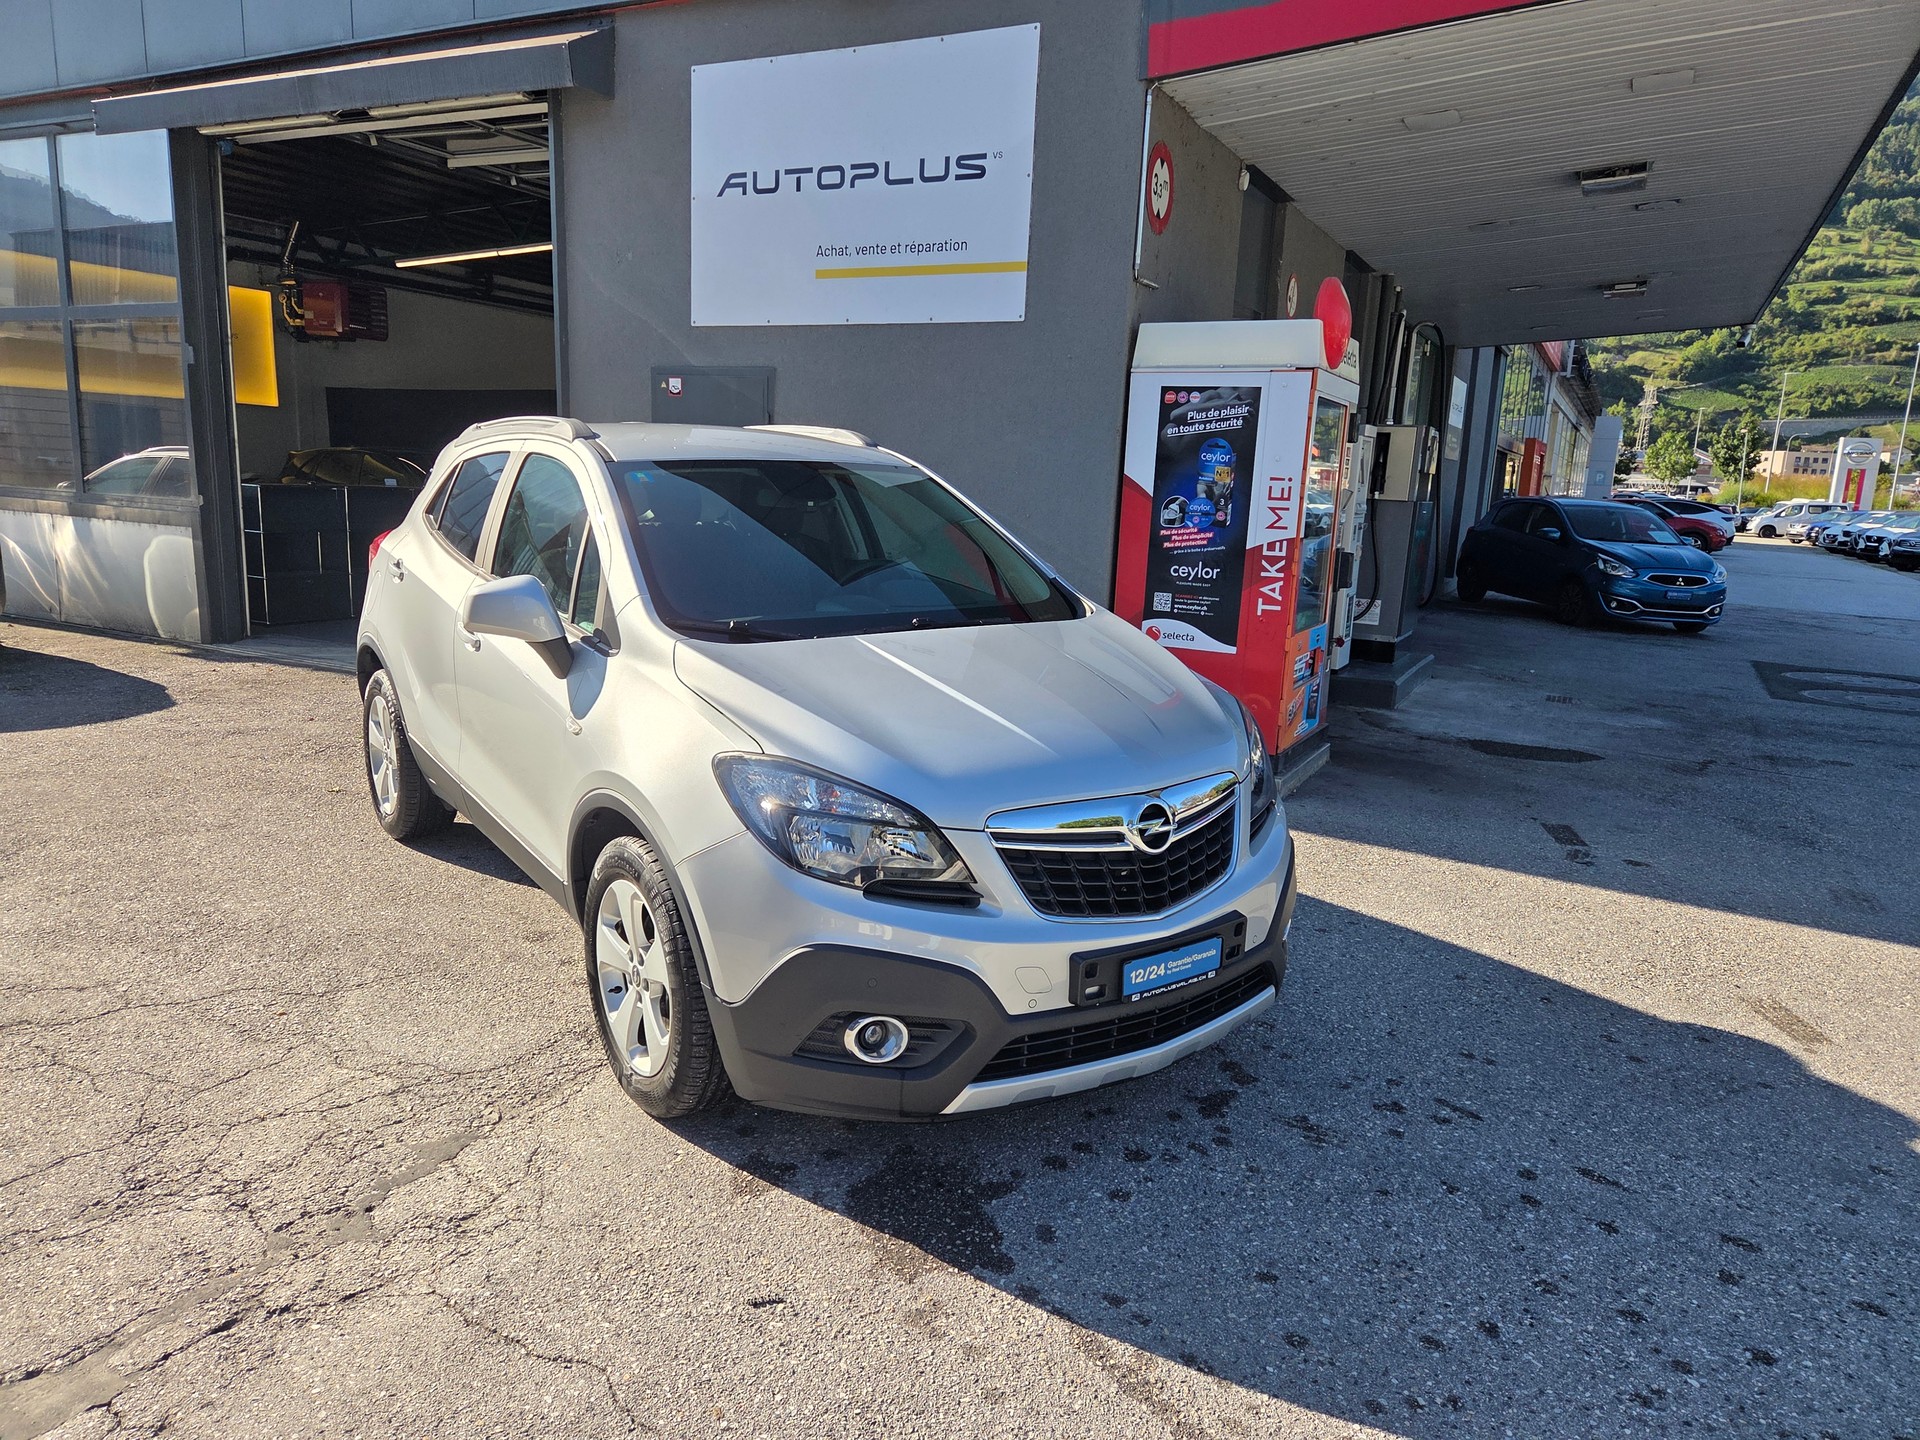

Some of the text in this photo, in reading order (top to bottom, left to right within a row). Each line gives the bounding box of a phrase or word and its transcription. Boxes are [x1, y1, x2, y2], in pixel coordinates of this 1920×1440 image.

[716, 151, 1004, 198] AUTOPLUS VS
[816, 239, 969, 258] Achat, vente et réparation
[1187, 405, 1250, 421] Plus de plaisir
[1167, 417, 1243, 435] en toute sécurité
[1200, 451, 1231, 463] ceylor
[1189, 532, 1213, 540] simplicité
[1257, 476, 1293, 616] TAKE ME!
[1170, 561, 1221, 581] ceylor
[1162, 632, 1195, 642] selecta
[1130, 962, 1166, 984] 12/24
